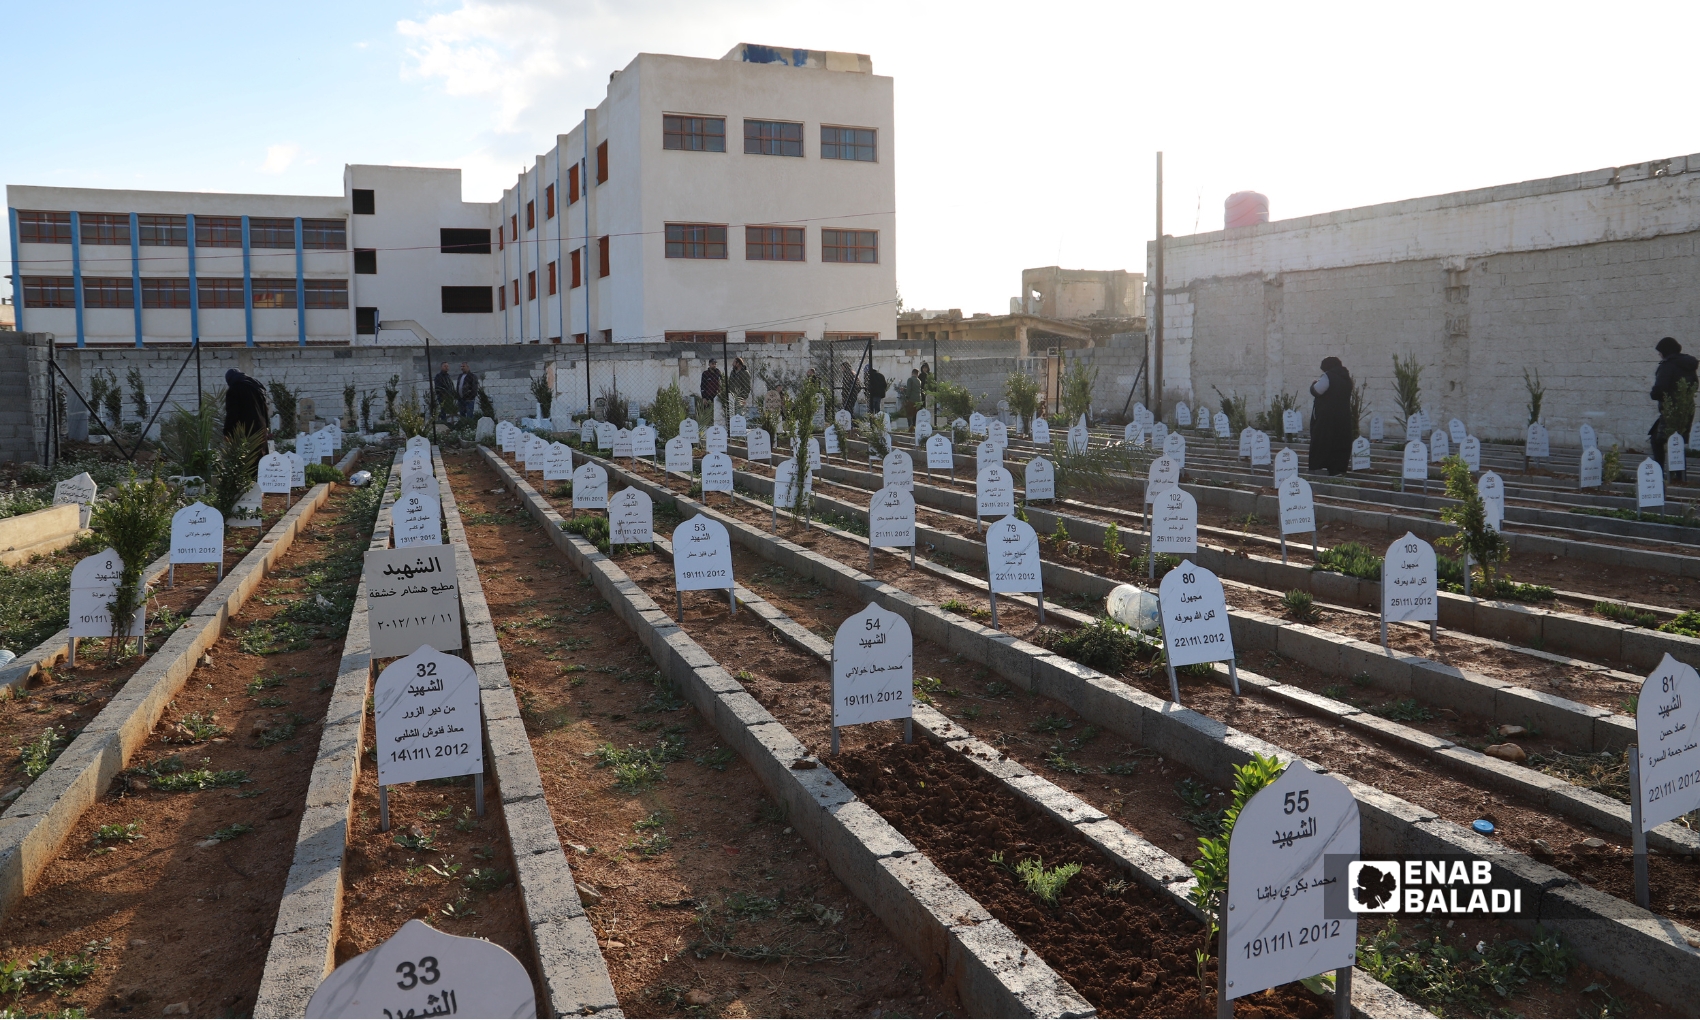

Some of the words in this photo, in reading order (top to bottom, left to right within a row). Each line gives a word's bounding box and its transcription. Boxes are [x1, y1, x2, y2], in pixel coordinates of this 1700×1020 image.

[694, 524, 706, 532] 53
[1006, 524, 1016, 532] 79
[691, 532, 710, 542] الشهيد
[1003, 534, 1020, 543] الشهيد
[1404, 544, 1417, 553] 103
[106, 561, 112, 569] 8
[383, 556, 442, 580] الشهيد
[1401, 561, 1419, 569] مجهول
[707, 570, 726, 578] 2012
[1182, 573, 1195, 584] 80
[1418, 576, 1427, 586] لكن
[400, 585, 428, 596] هشام
[430, 582, 454, 596] مطيع
[1180, 592, 1202, 603] مجهول
[1414, 597, 1432, 606] 2012
[1174, 613, 1192, 623] يعرفه
[1204, 610, 1215, 621] لكن
[866, 618, 880, 631] 54
[859, 633, 886, 648] الشهيد
[1174, 635, 1202, 647] 22\11\
[1203, 633, 1225, 644] 2012
[416, 662, 436, 678] 32
[845, 666, 868, 678] خولاني
[870, 664, 885, 674] جمال
[407, 679, 444, 696] الشهيد
[1662, 674, 1674, 693] 81
[844, 693, 874, 706] 19\11\
[877, 690, 903, 703] 2012
[428, 707, 442, 717] دير
[443, 706, 456, 714] من
[1658, 694, 1682, 718] الشهيد
[402, 706, 424, 719] الزور
[394, 728, 420, 743] الشلبي
[446, 725, 464, 734] معاذ
[390, 748, 430, 762] 14\11\
[435, 742, 468, 758] 2012
[1684, 741, 1698, 752] محمد
[1649, 781, 1676, 804] 22\11\
[1678, 768, 1700, 790] 2012
[1284, 790, 1310, 815] 55
[1272, 816, 1317, 848] الشهيد
[1311, 876, 1337, 888] محمد
[1257, 883, 1278, 900] باشا
[1280, 878, 1308, 900] بكري
[1243, 931, 1293, 960] 19\11\
[1299, 920, 1340, 945] 2012
[396, 956, 441, 991] 33
